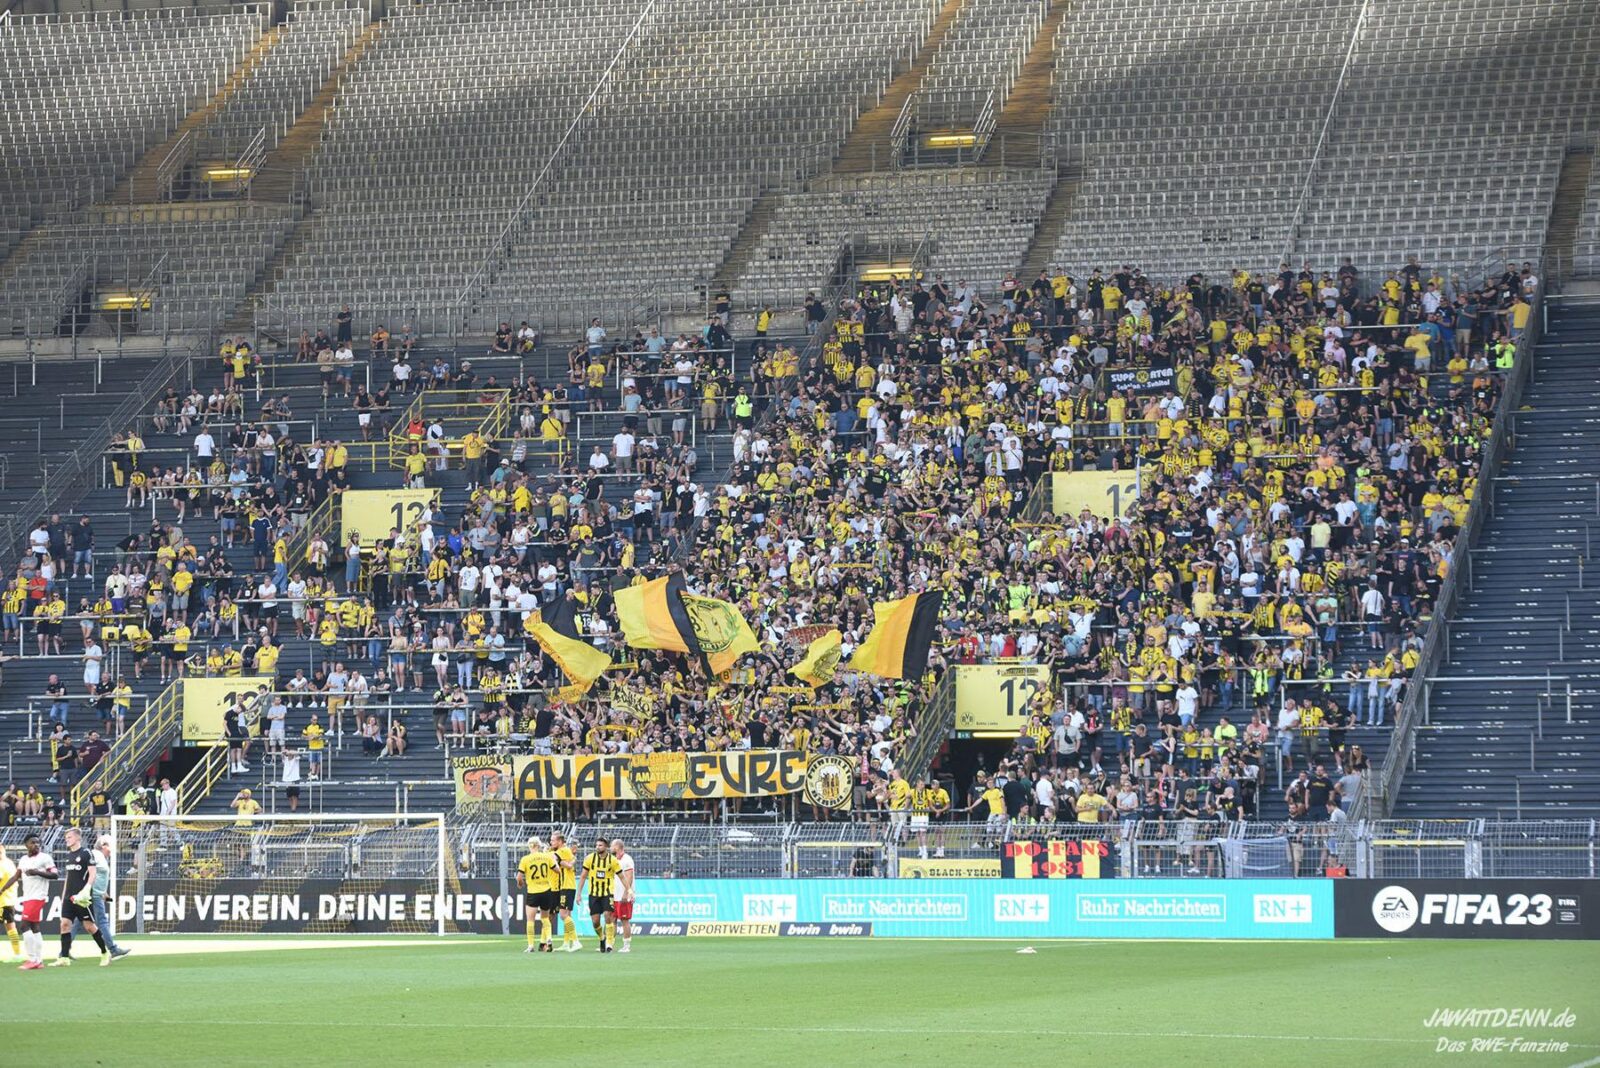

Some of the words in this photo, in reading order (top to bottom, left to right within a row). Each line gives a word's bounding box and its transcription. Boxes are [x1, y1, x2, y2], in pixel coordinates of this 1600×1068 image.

[391, 501, 425, 534] 12
[1000, 679, 1039, 716] 12
[519, 757, 630, 800] AMAT
[1005, 841, 1109, 857] DO-FANS
[529, 862, 548, 880] 20
[1030, 861, 1085, 876] 1981
[118, 894, 188, 921] DEIN
[194, 894, 309, 920] VEREIN.
[319, 894, 408, 920] DEINE
[619, 901, 712, 915] achrichten
[828, 901, 864, 915] Ruhr
[869, 900, 961, 916] Nachrichten
[1081, 899, 1118, 917] Ruhr
[1123, 899, 1221, 917] Nachrichten
[1421, 894, 1502, 925] FIFA
[1504, 893, 1552, 926] 23
[650, 923, 681, 935] bwin
[690, 924, 777, 935] SPORTWETTEN
[787, 924, 820, 936] bwin
[829, 924, 862, 936] bwin
